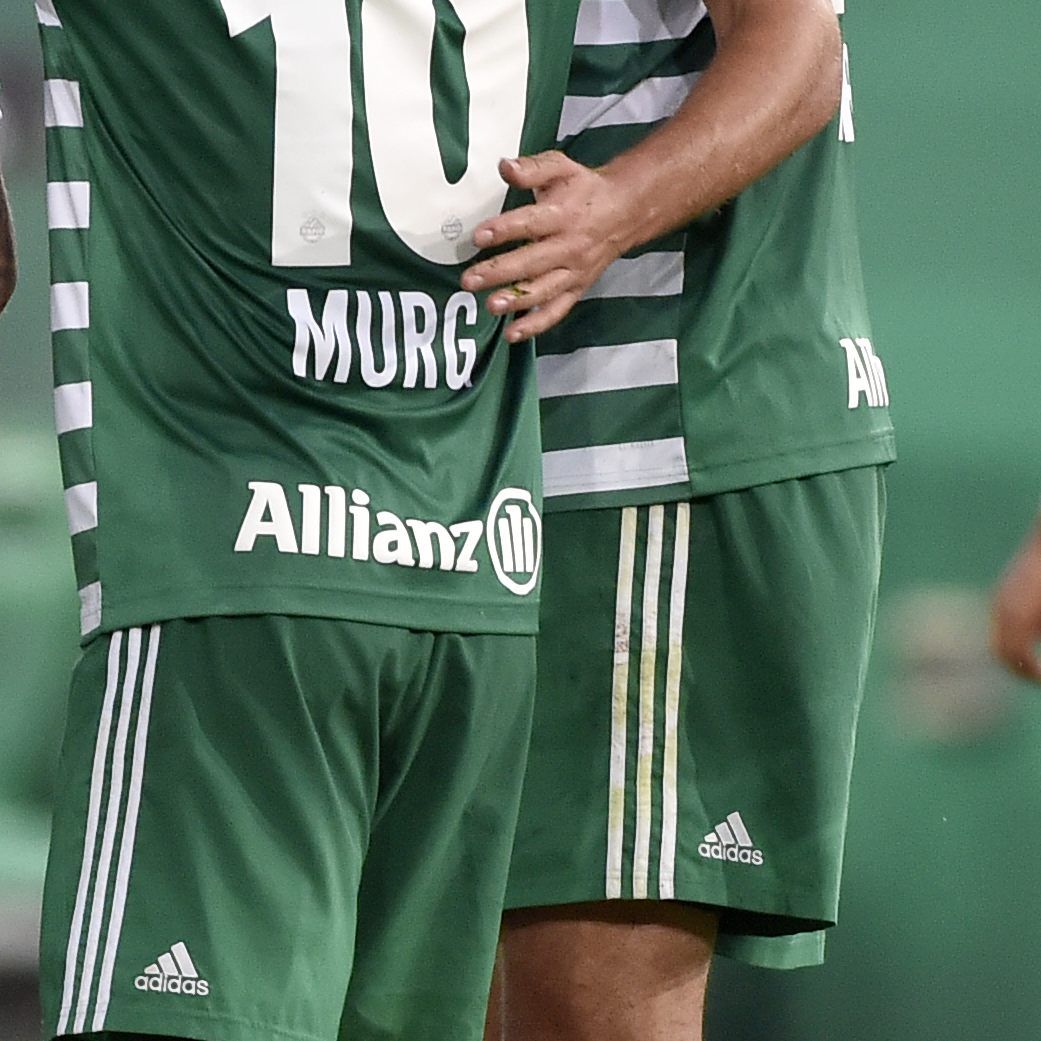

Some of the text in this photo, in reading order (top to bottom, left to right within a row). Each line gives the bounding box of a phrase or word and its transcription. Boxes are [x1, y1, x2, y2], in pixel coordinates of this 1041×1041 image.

[286, 288, 478, 390] MURG
[233, 481, 484, 573] Allianz
[698, 841, 764, 865] adidas
[134, 973, 209, 996] adidas
